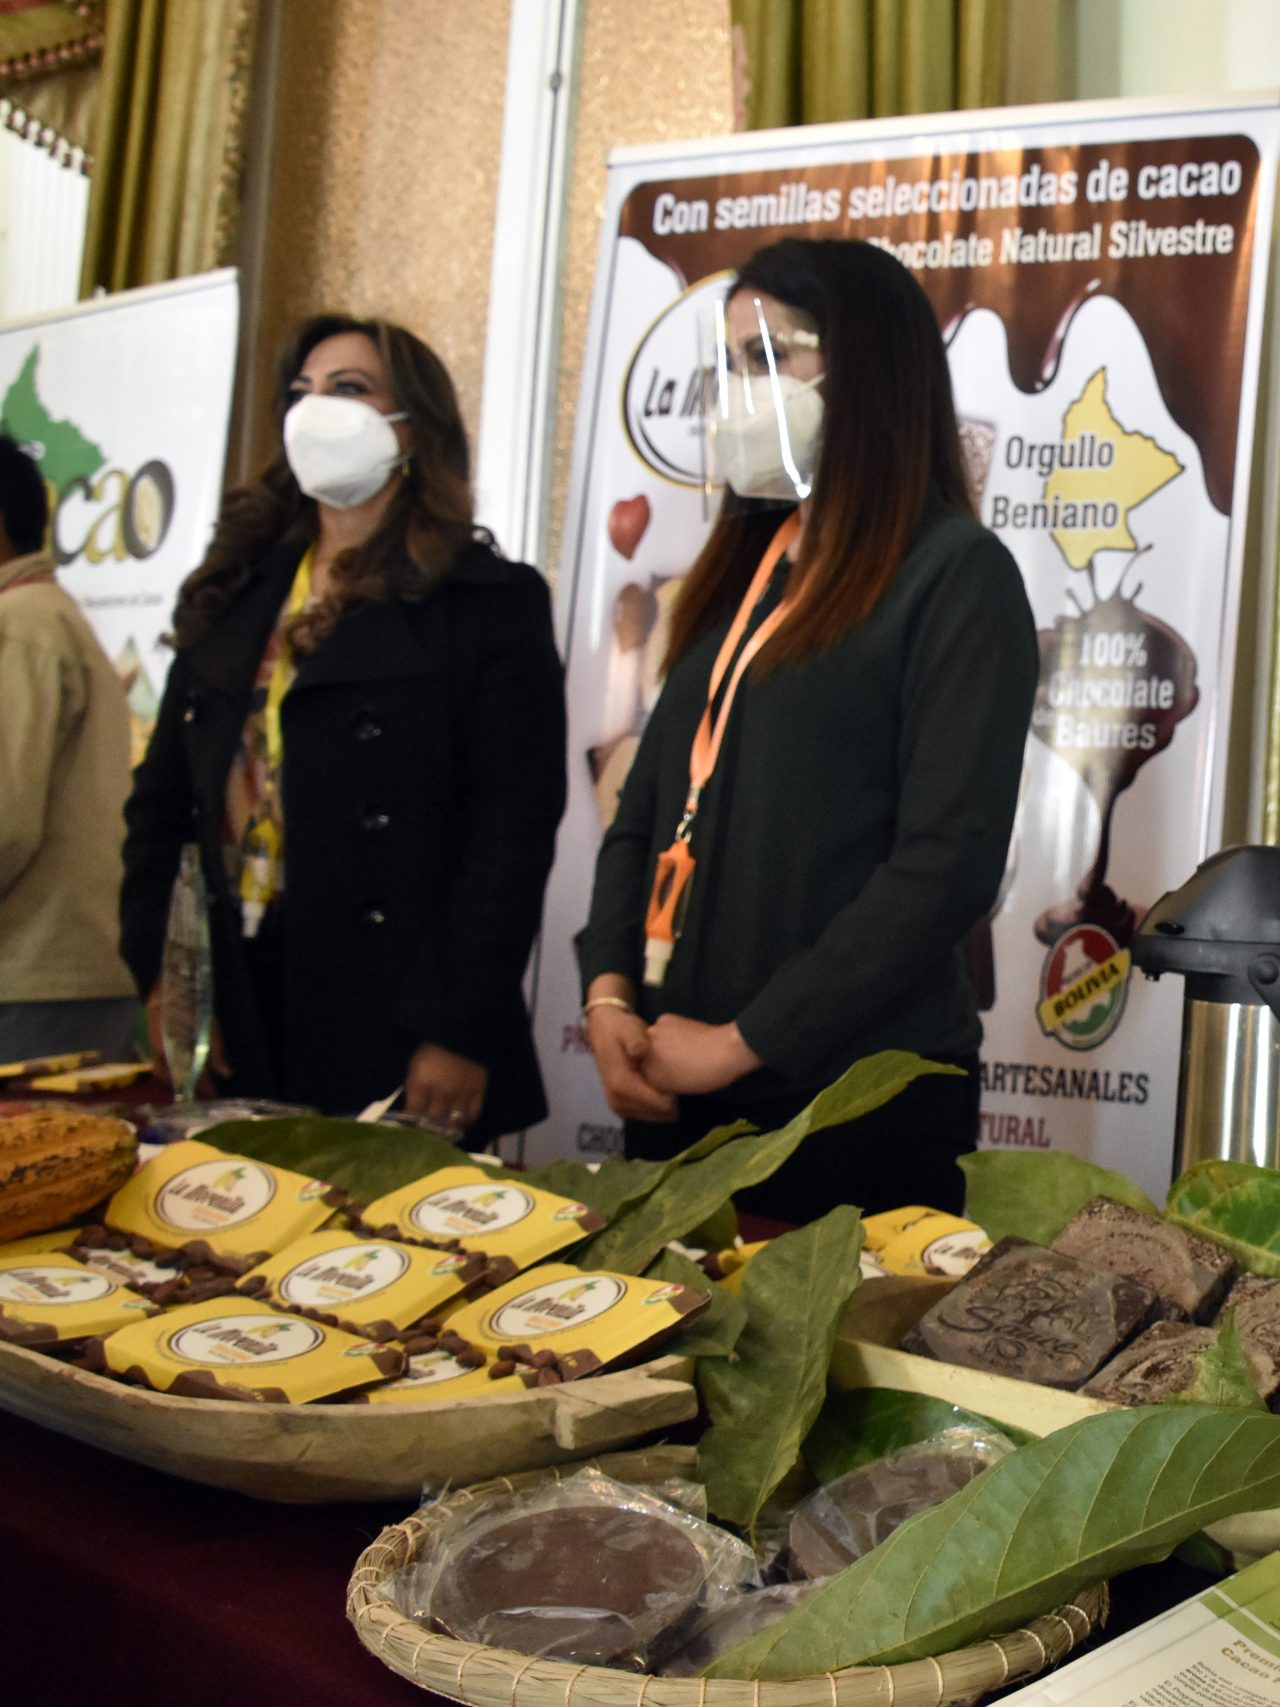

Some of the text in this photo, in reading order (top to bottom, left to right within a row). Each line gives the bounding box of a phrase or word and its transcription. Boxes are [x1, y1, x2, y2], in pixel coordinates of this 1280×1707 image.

[652, 158, 1242, 236] Con semillas seleccionadas de cacao
[999, 222, 1102, 266] Natural
[1108, 218, 1235, 260] Silvestre
[1005, 433, 1114, 477] Orgullo
[42, 458, 176, 566] cao
[992, 495, 1119, 529] Beniano
[1079, 632, 1148, 668] 100%
[1049, 672, 1175, 710] Chocolate
[1055, 714, 1157, 750] Baures
[1052, 962, 1120, 1018] BOLIVIA
[978, 1060, 1150, 1105] ARTESANALES
[1221, 1647, 1270, 1680] Cacao
